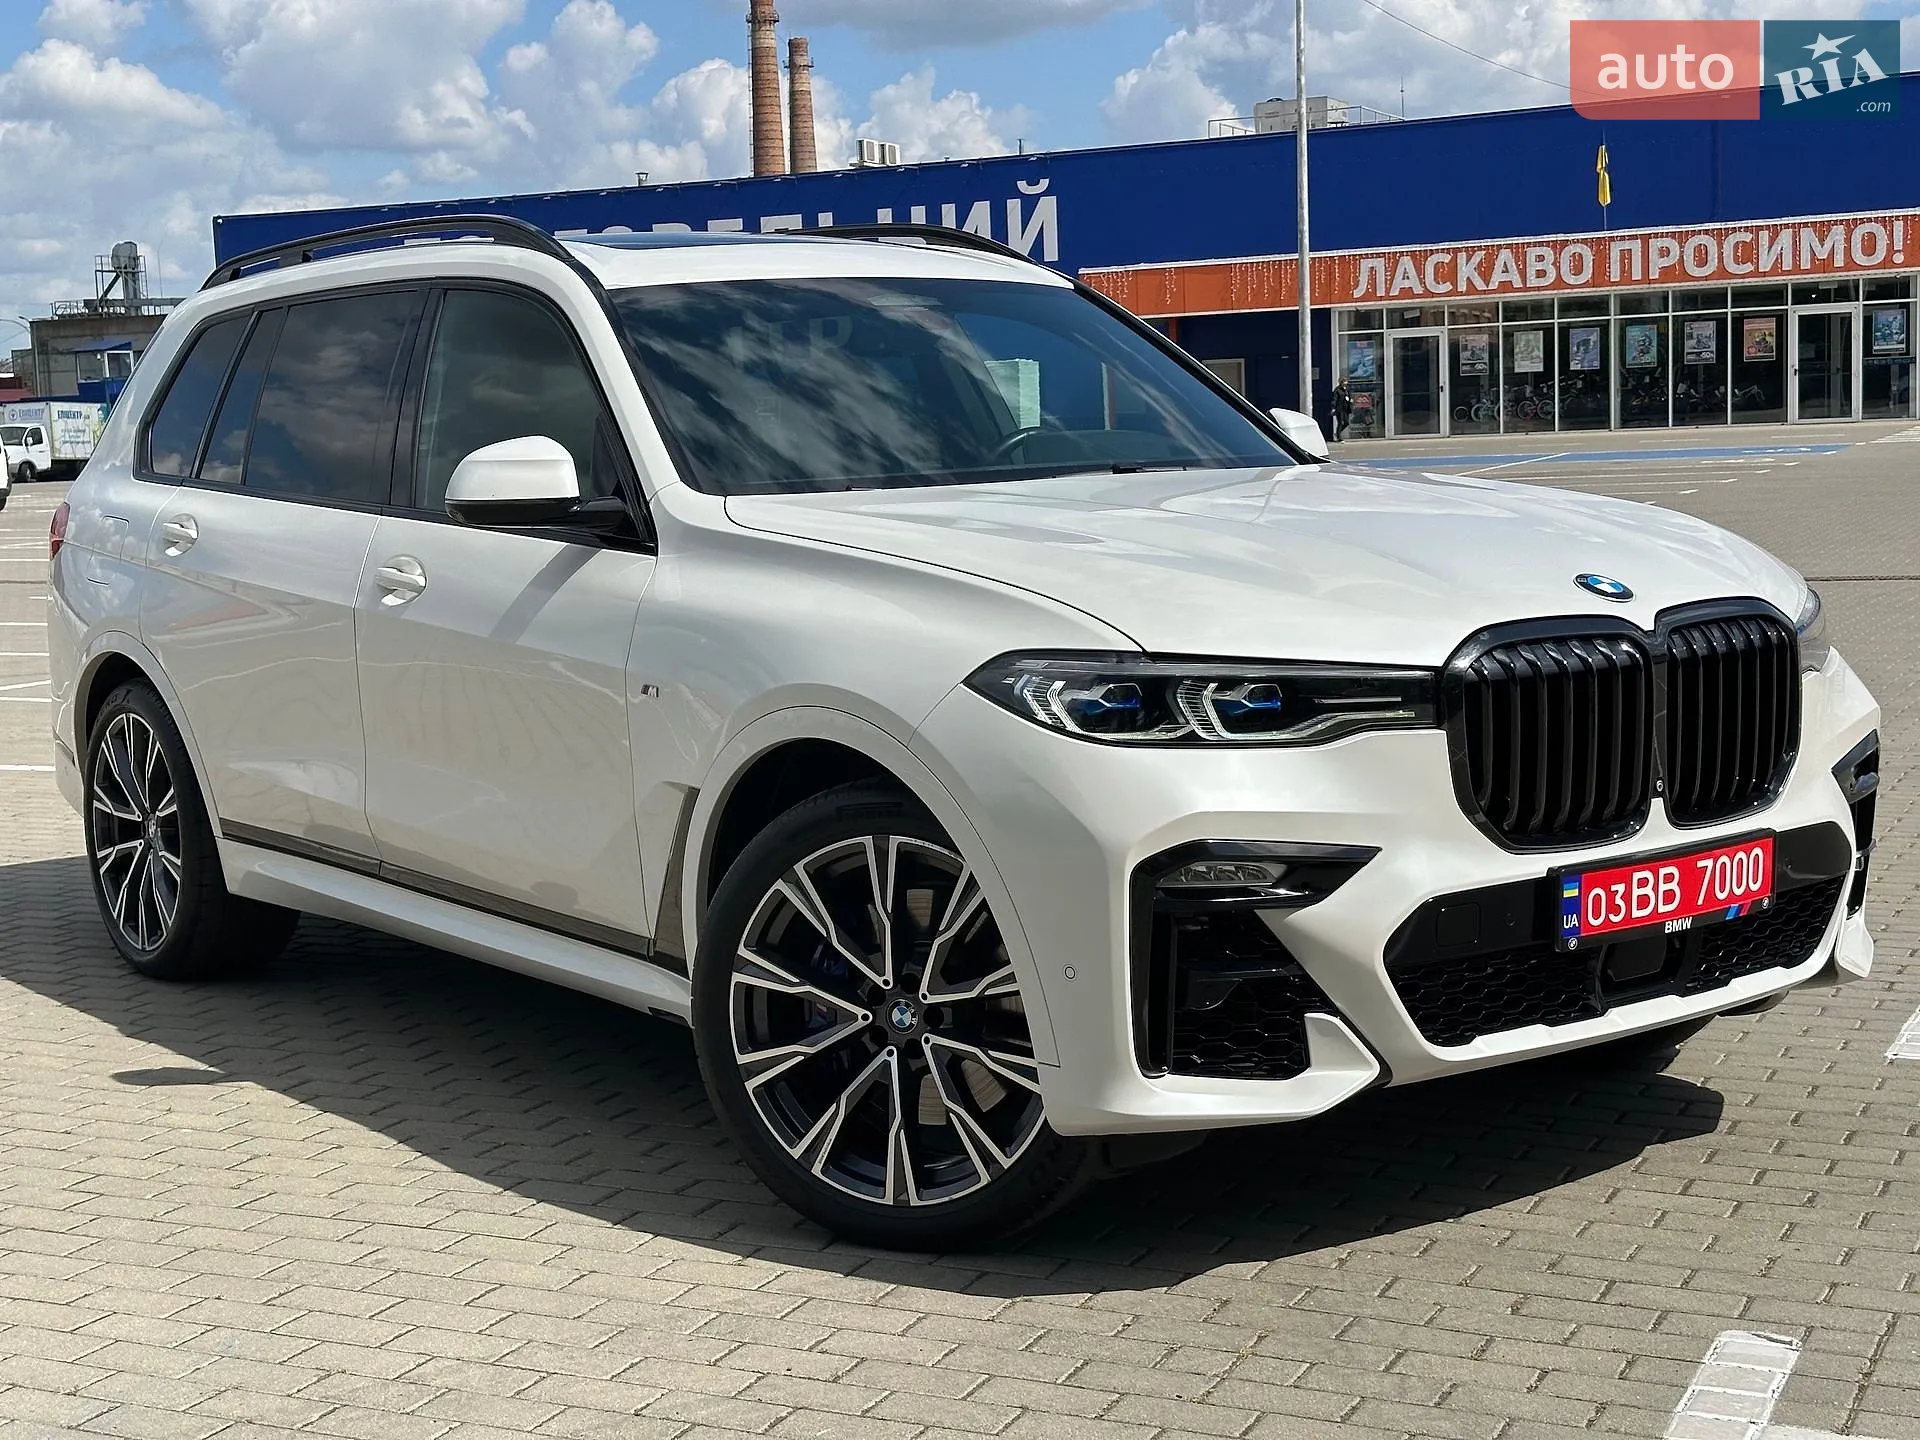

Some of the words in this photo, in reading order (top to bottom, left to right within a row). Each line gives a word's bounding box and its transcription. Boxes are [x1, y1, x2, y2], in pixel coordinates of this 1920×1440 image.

[1353, 243, 1594, 299] ЛАСКАВО
[1609, 221, 1905, 282] ПРОСИМО!
[1587, 865, 1681, 927] 03BB
[1696, 846, 1765, 906] 7000
[1563, 913, 1579, 929] UA
[1664, 916, 1693, 934] BMW
